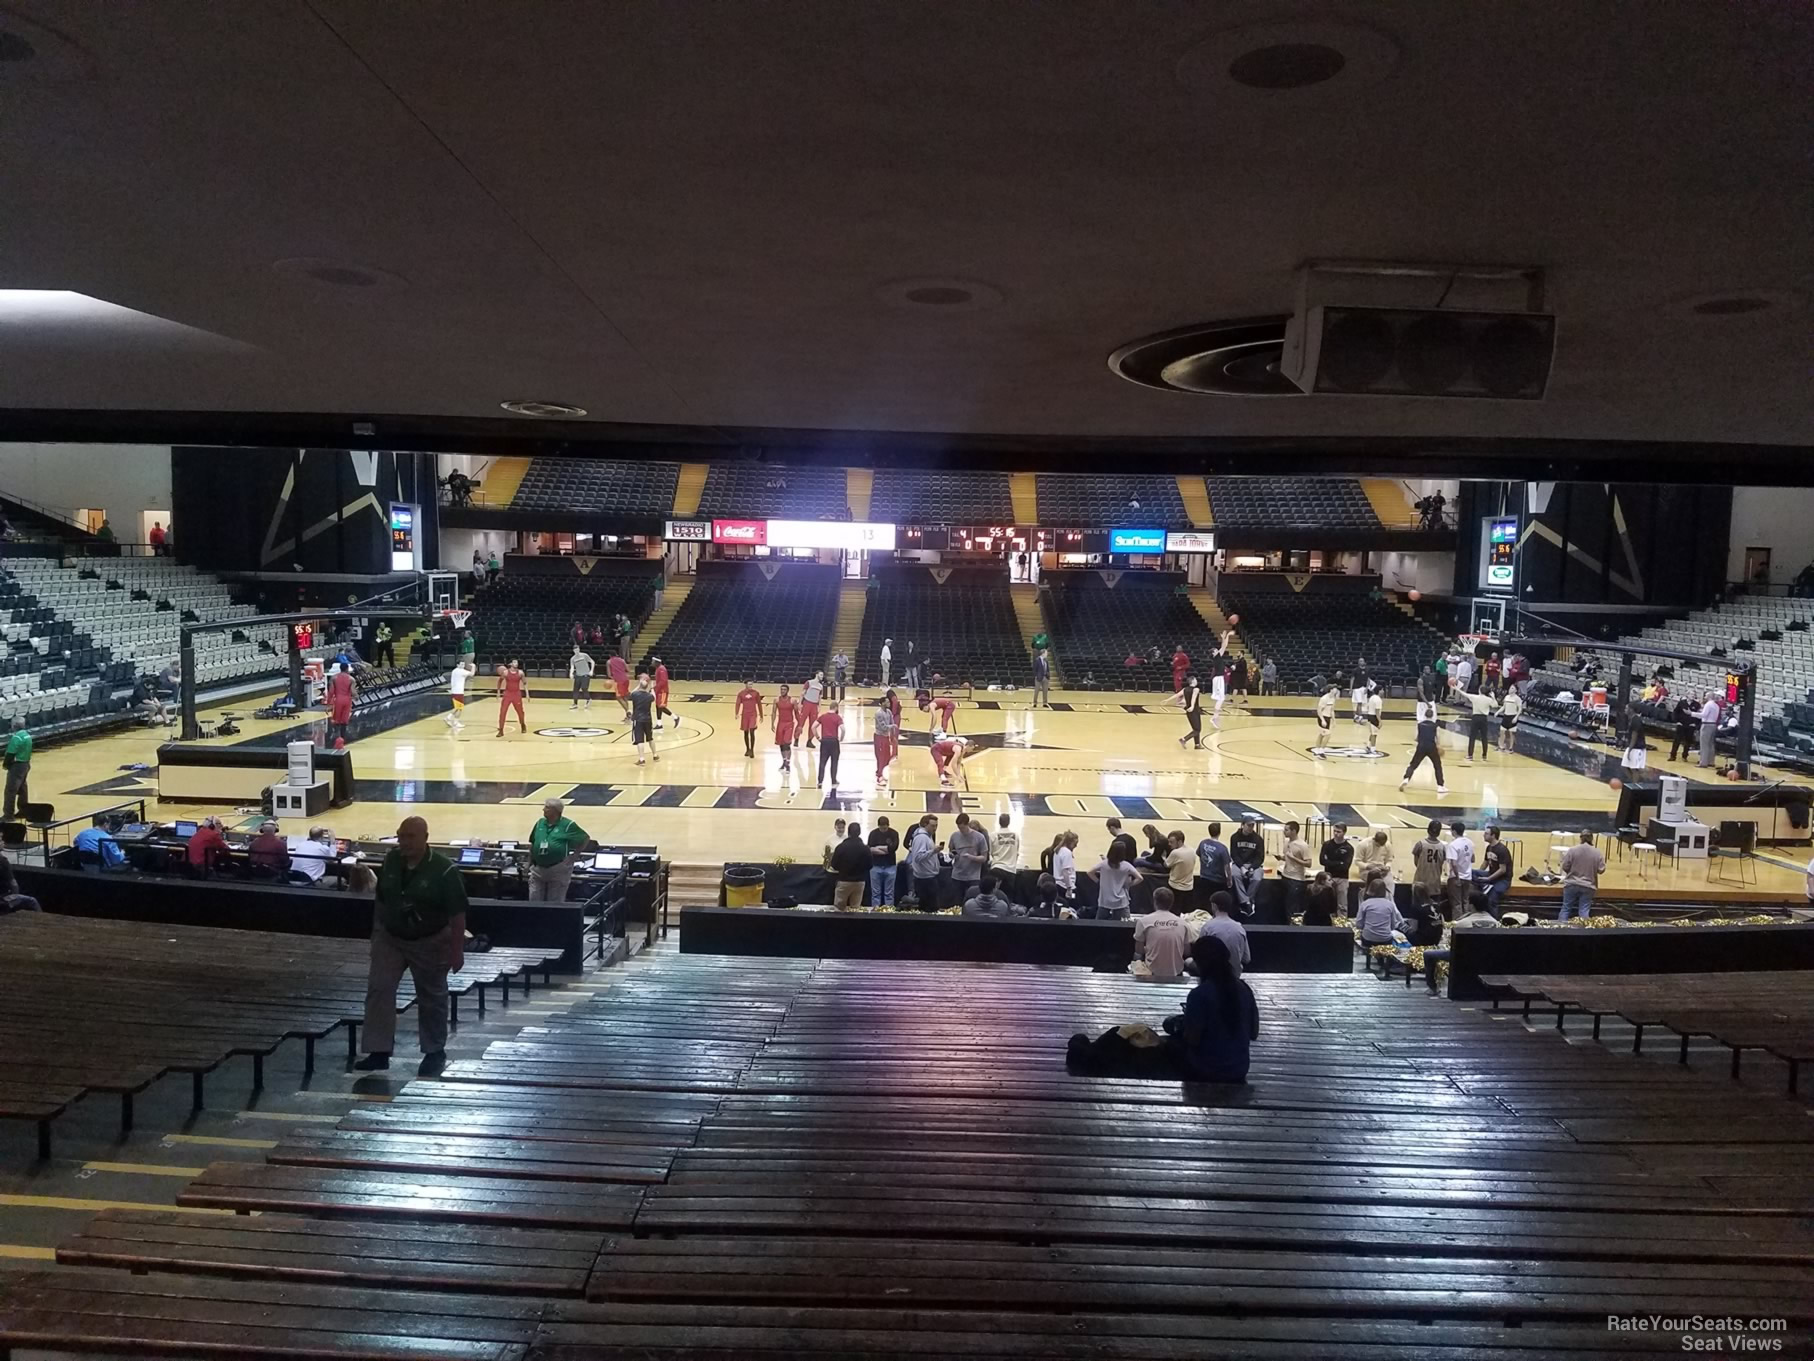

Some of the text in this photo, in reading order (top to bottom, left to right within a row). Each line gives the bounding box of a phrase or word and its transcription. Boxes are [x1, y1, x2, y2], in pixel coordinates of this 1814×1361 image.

[965, 540, 972, 549] 0
[984, 541, 992, 551] 0
[1019, 541, 1026, 551] 0
[1037, 541, 1044, 551] 0
[580, 560, 590, 568] A
[765, 564, 775, 574] B
[937, 568, 946, 578] C
[1105, 573, 1116, 582] D
[1294, 576, 1304, 585] E
[1427, 848, 1439, 863] 24
